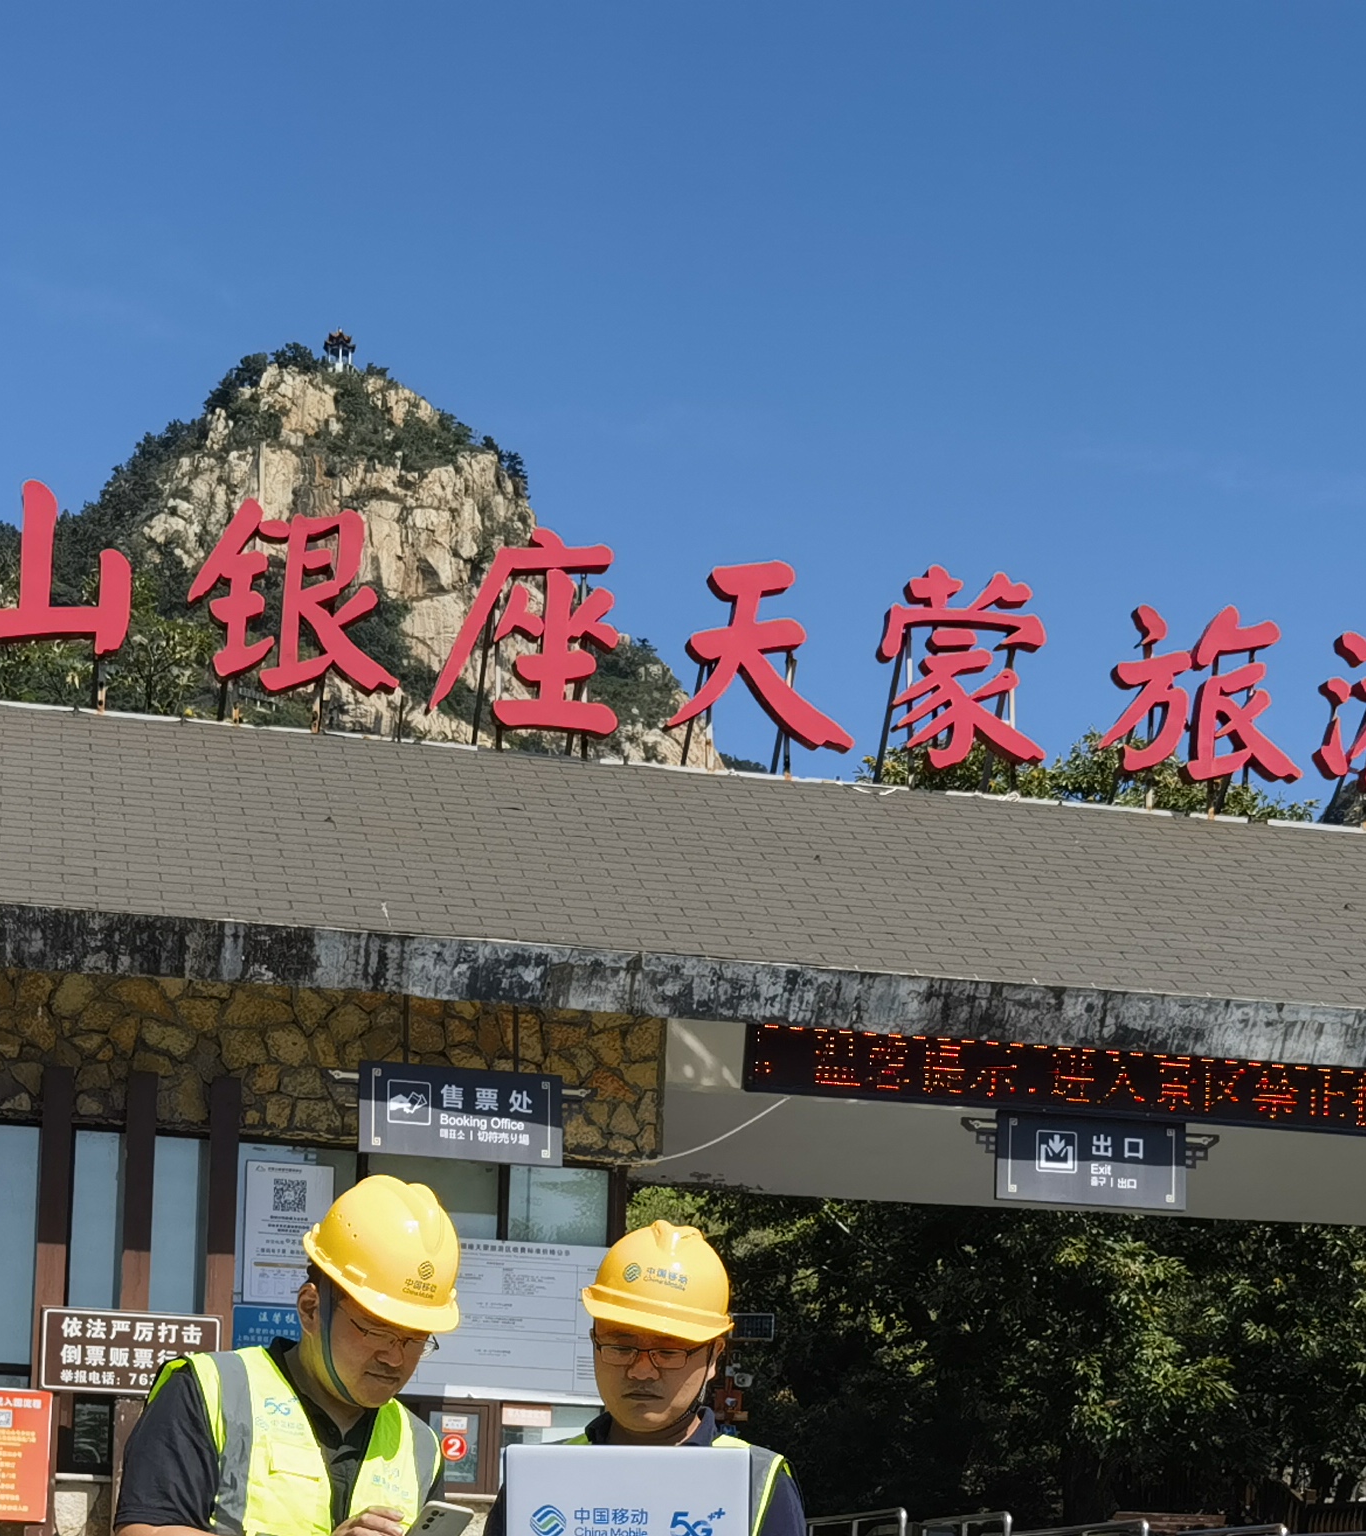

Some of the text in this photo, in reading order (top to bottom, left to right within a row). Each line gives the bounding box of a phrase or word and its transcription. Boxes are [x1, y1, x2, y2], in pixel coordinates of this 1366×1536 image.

[440, 1084, 533, 1114] 售票处
[440, 1114, 525, 1131] Booking Office
[1091, 1134, 1144, 1160] 出口
[1090, 1163, 1112, 1175] Exit
[1117, 1177, 1137, 1189] 出口
[61, 1316, 203, 1345] 依法严厉打击
[446, 1438, 461, 1456] 2
[574, 1507, 648, 1525] 中国移动
